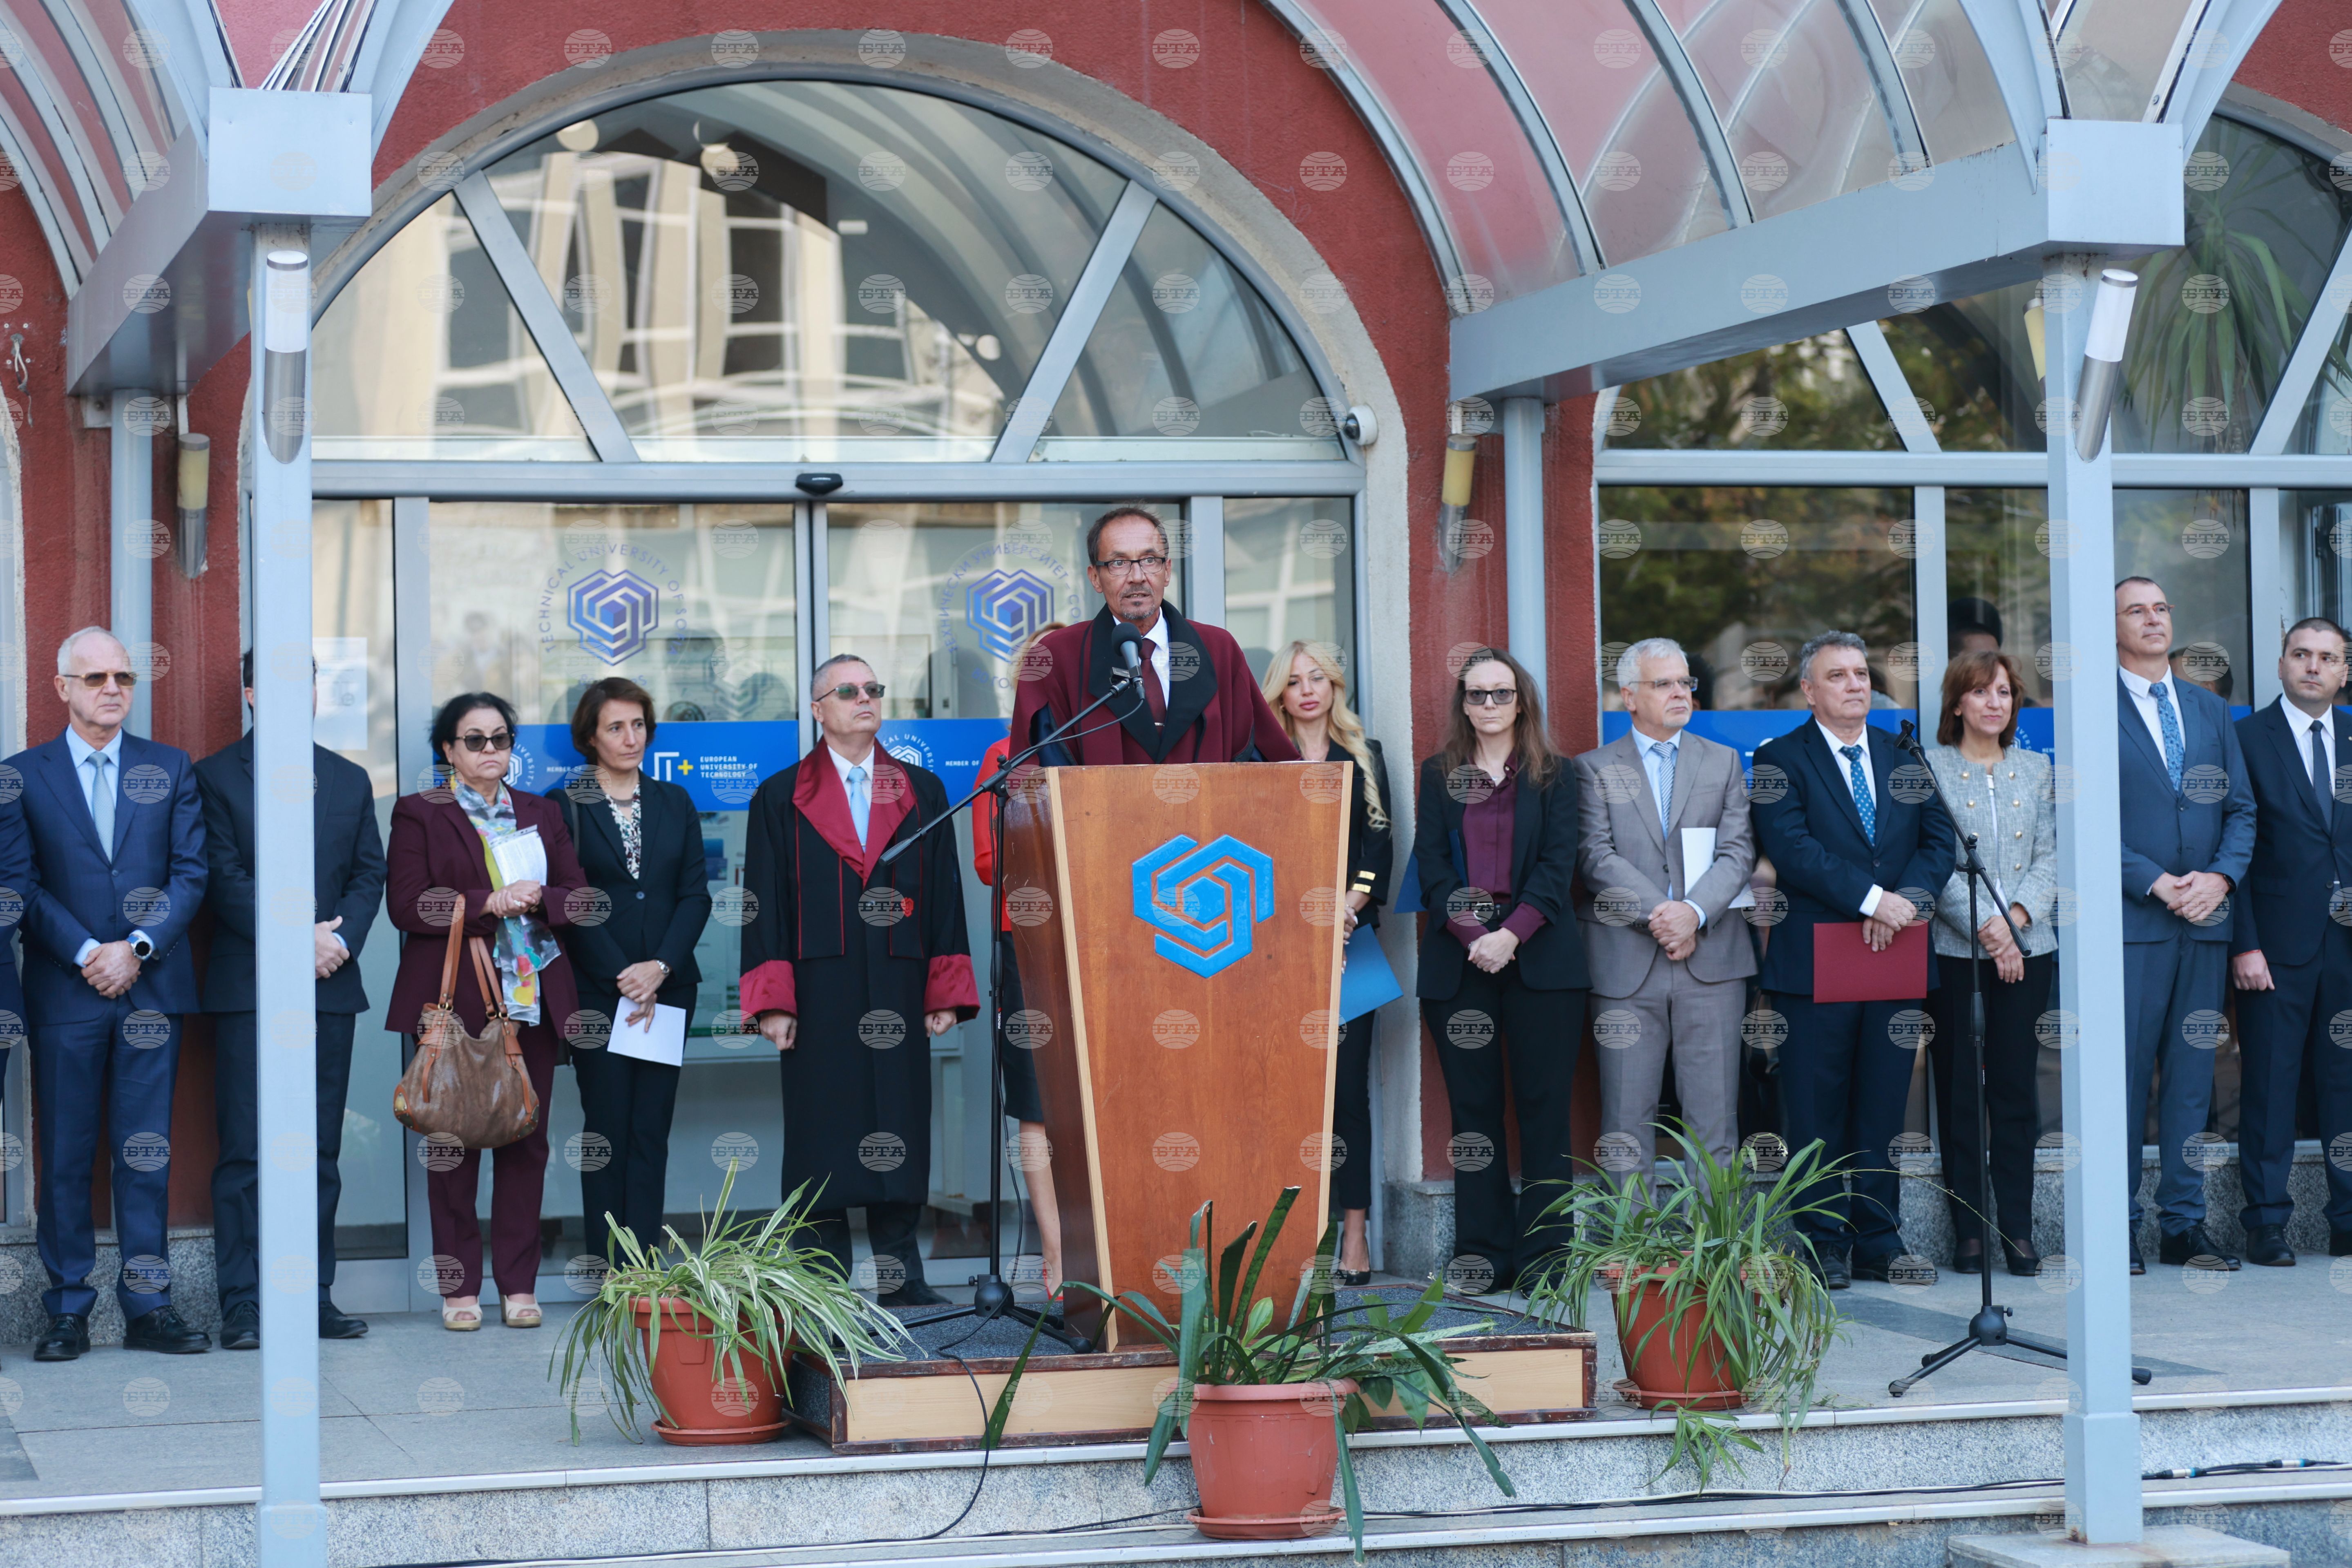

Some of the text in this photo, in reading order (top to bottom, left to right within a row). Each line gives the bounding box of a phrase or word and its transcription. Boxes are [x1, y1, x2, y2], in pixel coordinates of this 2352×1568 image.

[539, 543, 688, 656] TECHNICAL UNIVERSITY OF SOFIA
[939, 560, 972, 653] ТЕХНИЧЕСКИ
[972, 542, 1069, 580] УНИВЕРСИТЕТ
